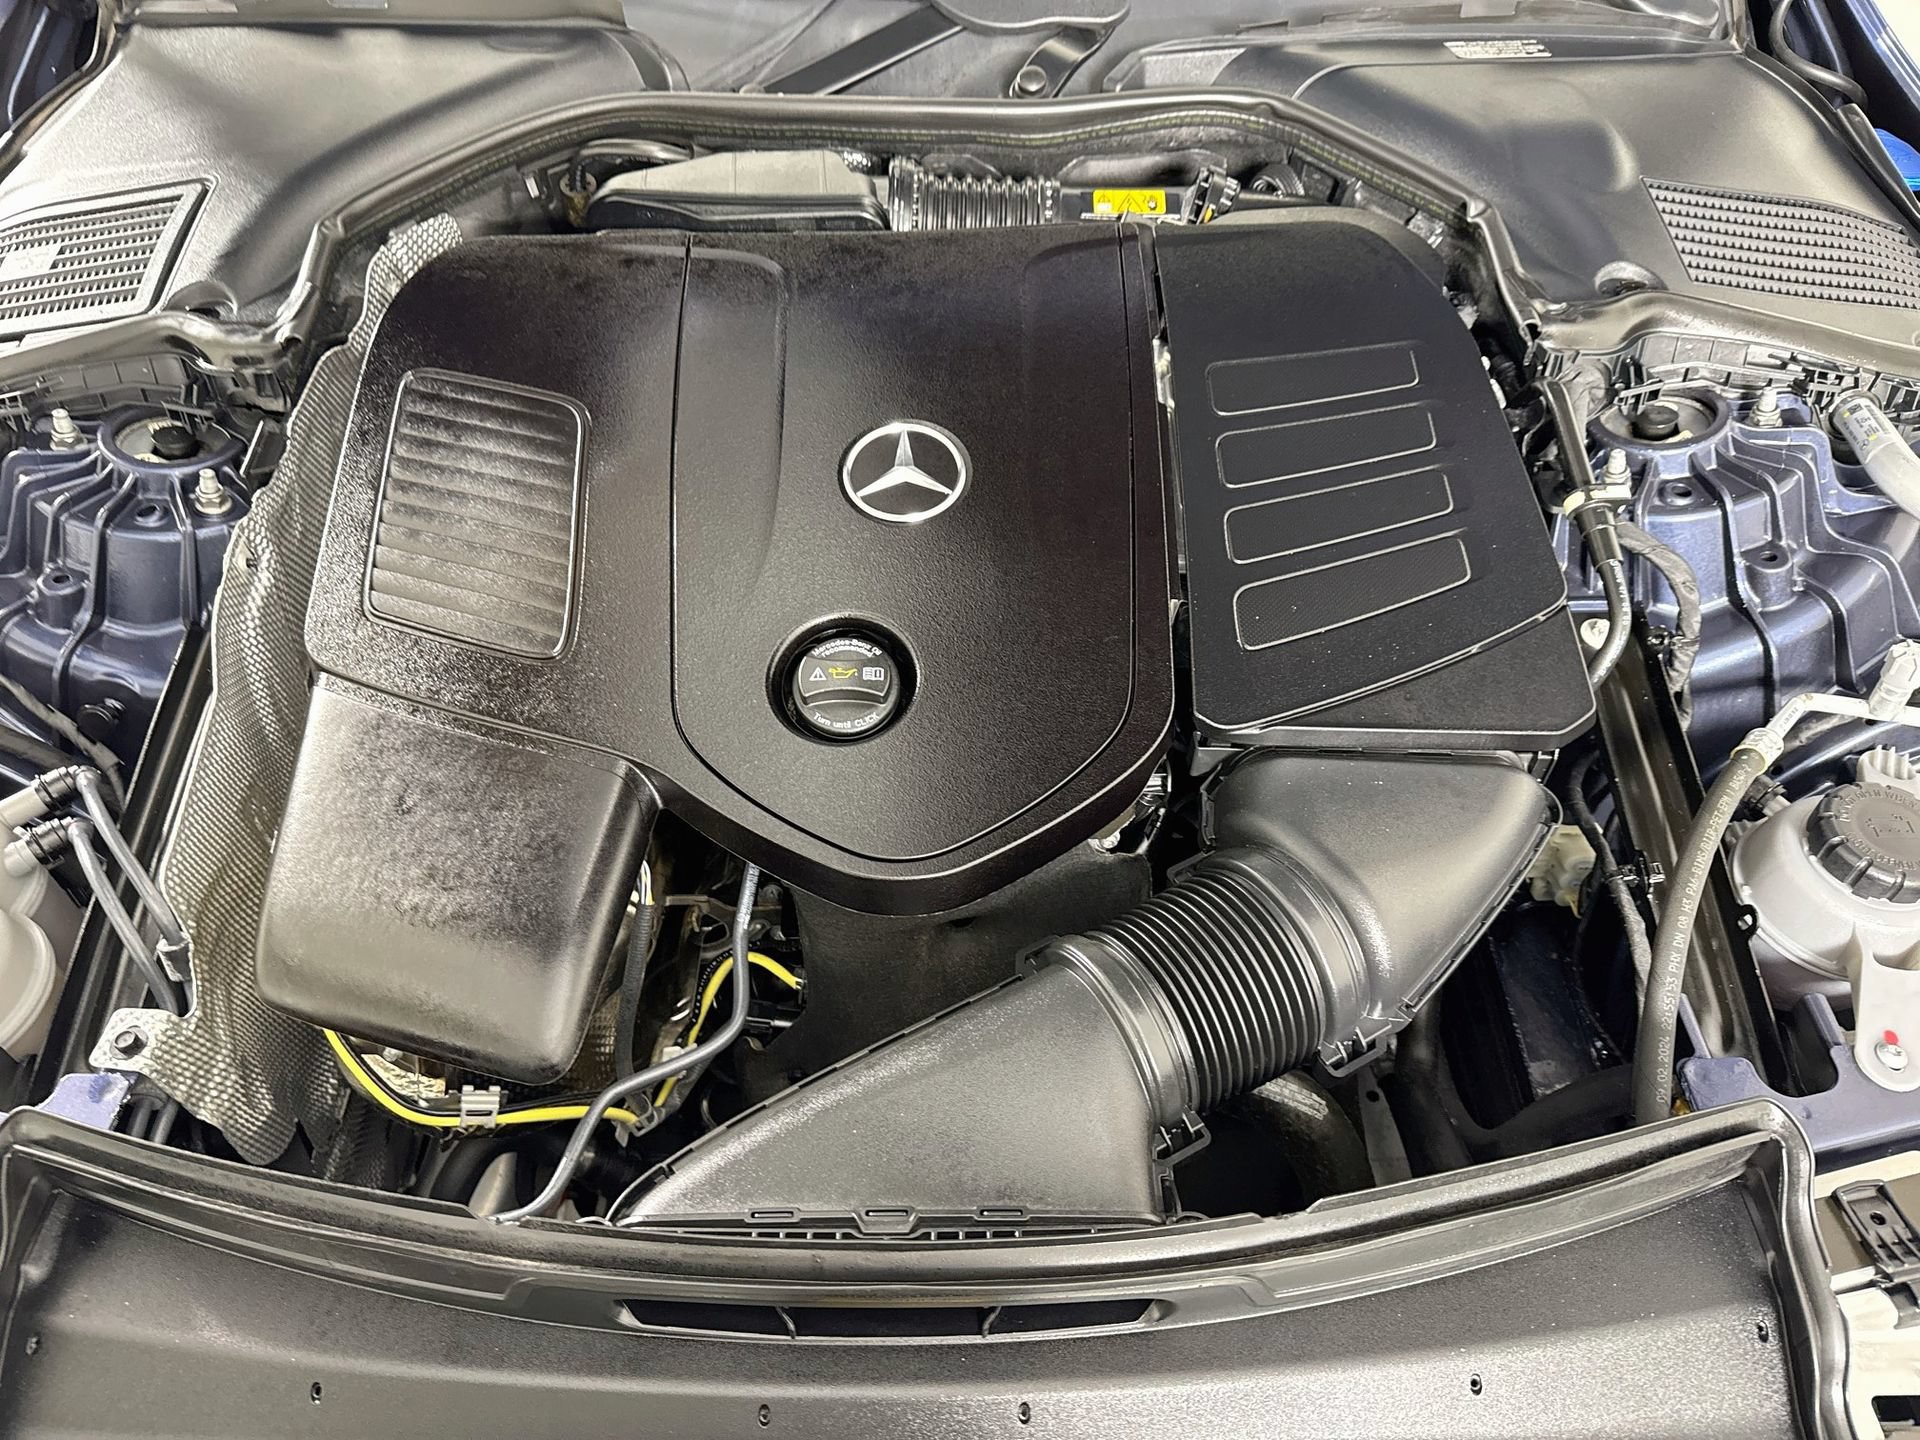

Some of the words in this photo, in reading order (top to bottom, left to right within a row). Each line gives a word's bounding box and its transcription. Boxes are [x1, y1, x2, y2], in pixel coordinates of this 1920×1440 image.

[812, 639, 872, 657] Mercedes-Benz
[821, 645, 874, 658] recommended
[813, 712, 831, 726] Turn
[833, 720, 851, 728] until
[854, 711, 880, 727] CLICK
[1672, 932, 1686, 948] DN
[1681, 898, 1694, 914] H3
